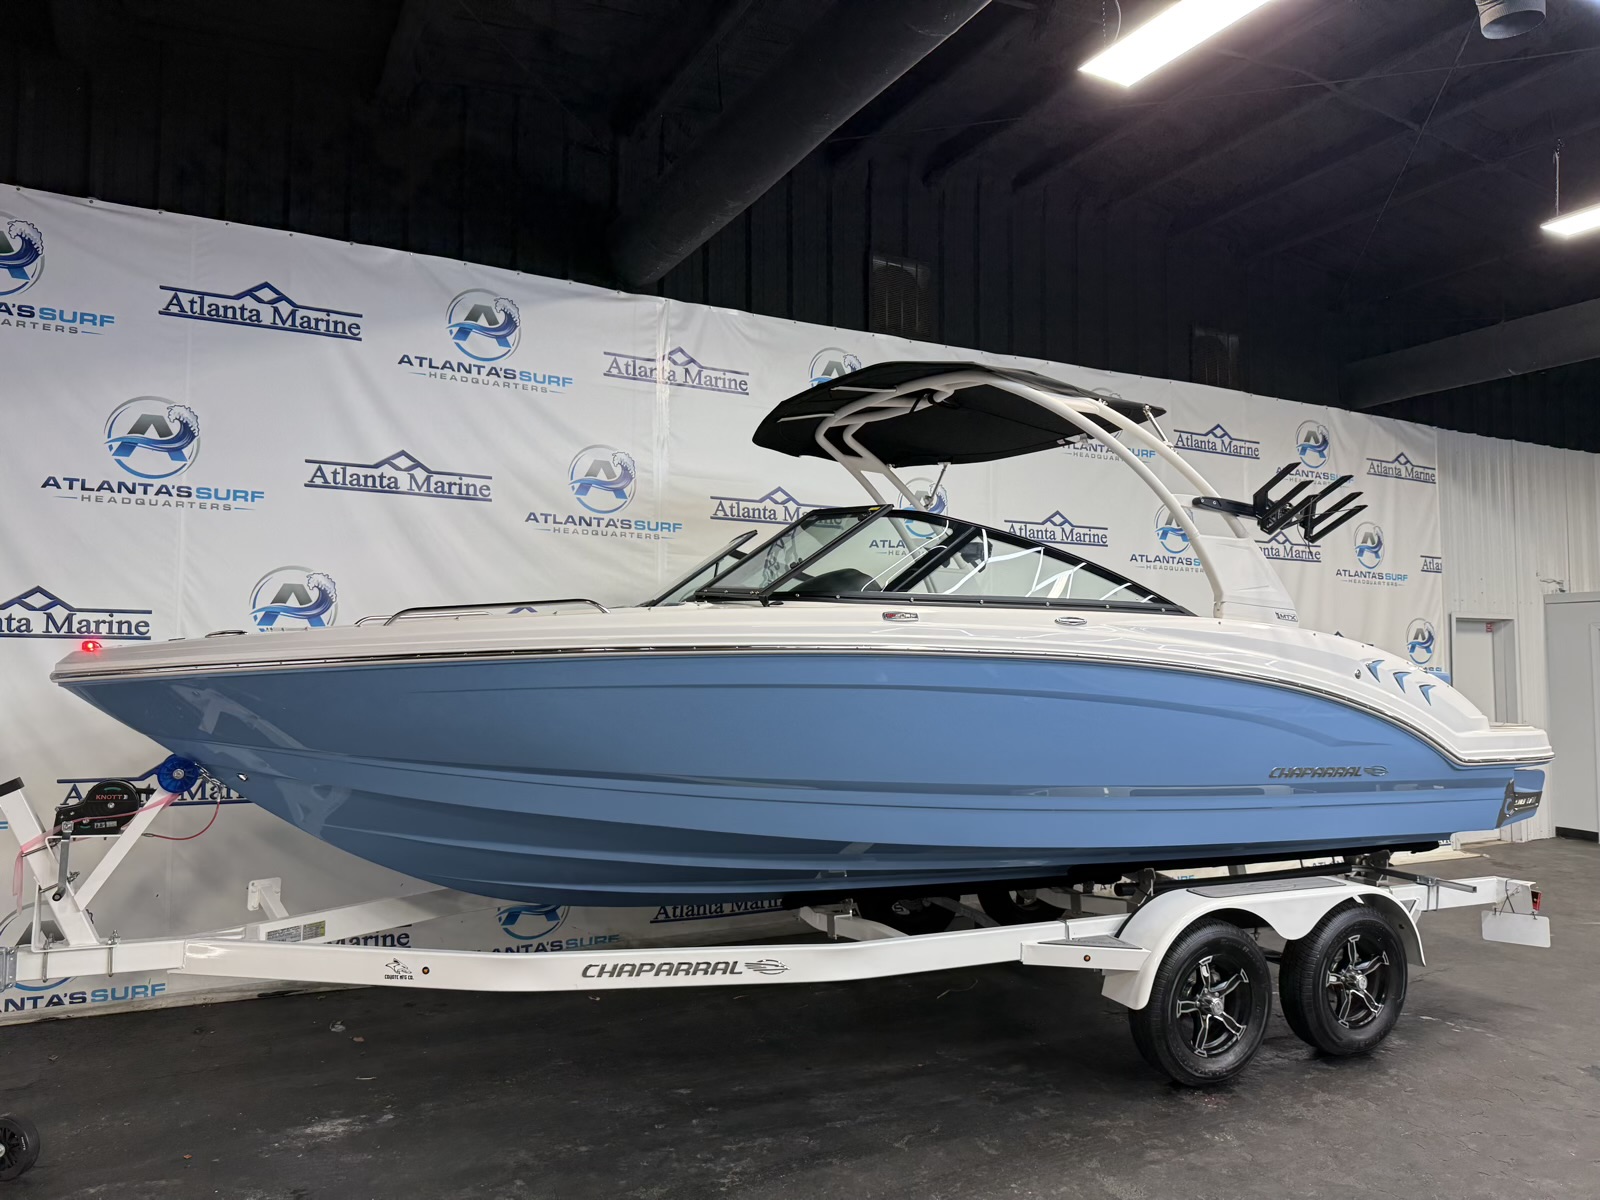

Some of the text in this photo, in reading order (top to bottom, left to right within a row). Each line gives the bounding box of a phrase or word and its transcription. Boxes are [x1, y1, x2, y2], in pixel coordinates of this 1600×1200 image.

[39, 307, 115, 328] SURF
[162, 291, 362, 337] Atlanta Marine
[429, 371, 549, 394] HEADQUARTERS
[518, 369, 573, 388] SURF
[682, 366, 749, 392] Marine
[1127, 447, 1156, 459] URF
[1175, 432, 1260, 457] Atlanta Marine
[307, 463, 492, 499] Atlanta Marine
[1367, 461, 1436, 482] Atlanta Marine
[80, 494, 232, 512] HEADQUARTERS
[194, 487, 265, 503] SURF
[712, 499, 778, 521] Atlanta
[553, 526, 661, 541] HEADQUARTERS
[633, 519, 683, 533] SURF
[1008, 523, 1108, 544] Atlanta Marine
[42, 611, 150, 636] Marine
[1268, 766, 1362, 779] CHAPARRAL
[653, 904, 724, 920] Atlanta
[565, 933, 620, 949] SURF
[580, 960, 743, 979] CHAPARRAL
[90, 983, 166, 1003] SURF
